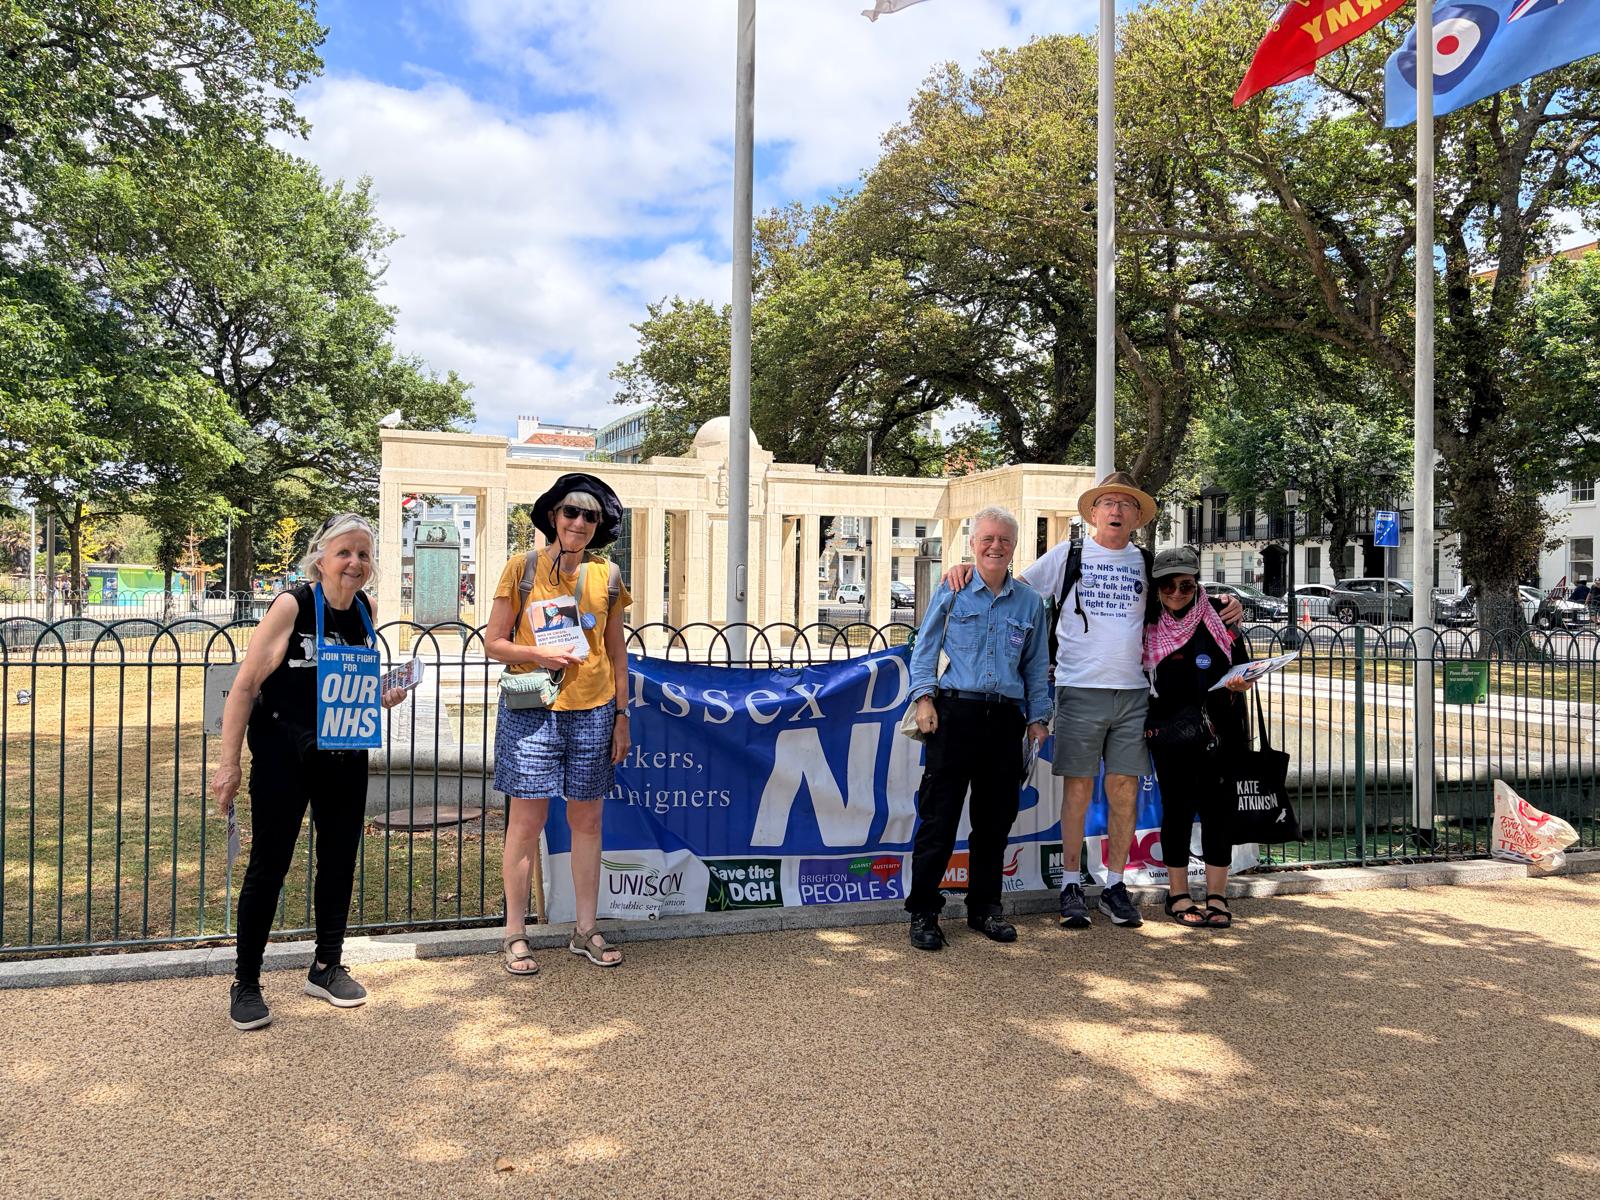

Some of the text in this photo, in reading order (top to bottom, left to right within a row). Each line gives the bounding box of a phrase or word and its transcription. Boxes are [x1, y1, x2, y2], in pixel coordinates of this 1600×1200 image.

[1097, 564, 1114, 572] NHS
[1116, 566, 1129, 574] will
[1103, 582, 1118, 590] folk
[1120, 583, 1133, 591] left
[1079, 590, 1095, 598] with
[1113, 592, 1130, 601] faith
[1132, 594, 1140, 602] to
[1085, 599, 1104, 609] fight
[1106, 601, 1117, 609] for
[321, 652, 377, 663] JOIN THE FIGHT
[343, 663, 357, 672] FOR
[321, 673, 378, 704] OUR
[856, 655, 911, 714] D
[321, 707, 378, 738] NHS
[621, 744, 703, 774] rkers,
[1236, 780, 1260, 795] KATE
[1238, 793, 1279, 811] ATKINSN
[709, 864, 774, 881] Save the
[849, 862, 872, 870] AGAINST
[800, 873, 848, 884] BRIGHTON
[941, 867, 968, 882] MB
[609, 871, 684, 897] UNISON
[728, 881, 776, 902] DGH
